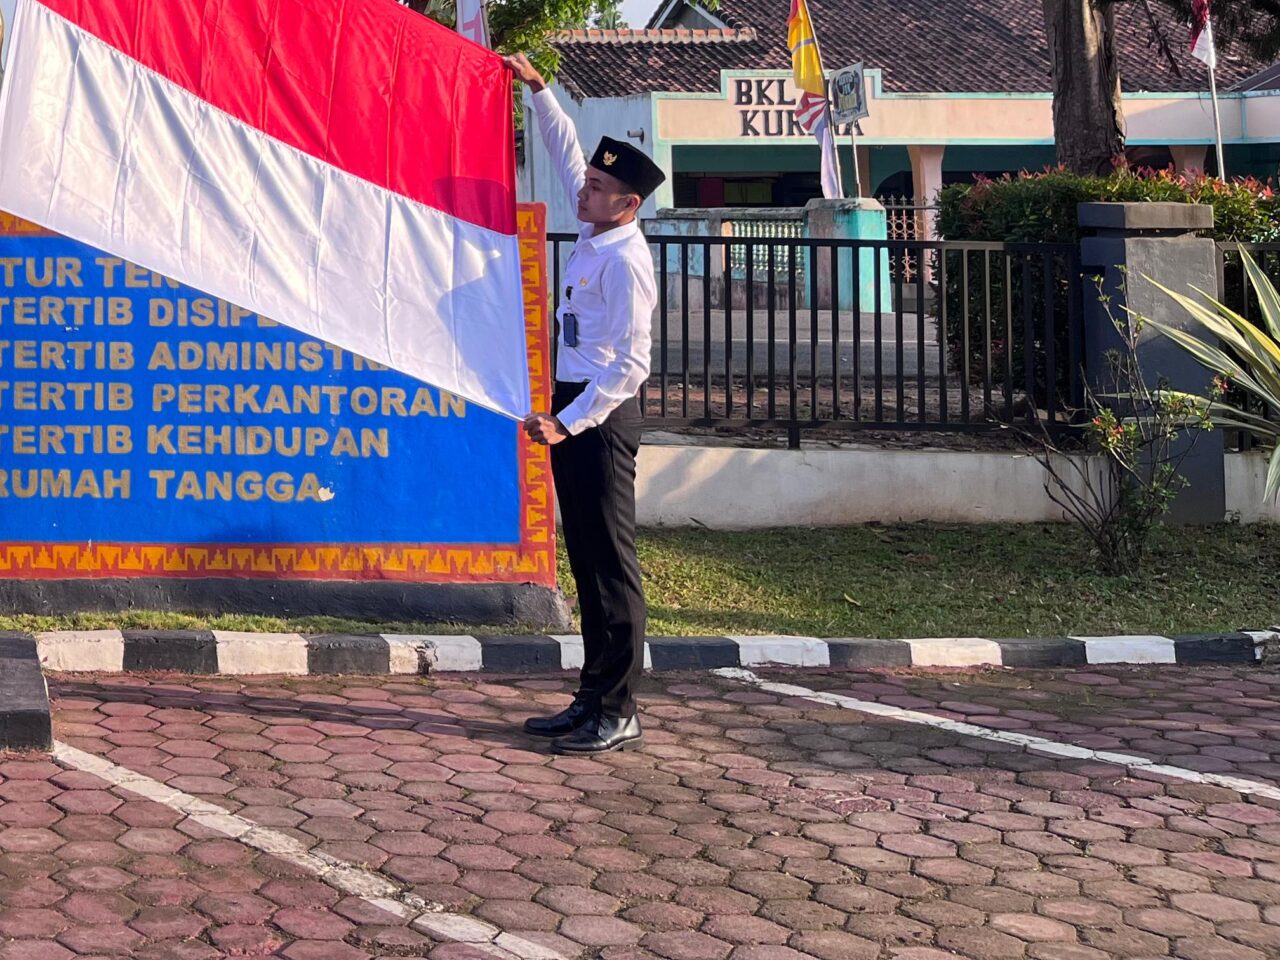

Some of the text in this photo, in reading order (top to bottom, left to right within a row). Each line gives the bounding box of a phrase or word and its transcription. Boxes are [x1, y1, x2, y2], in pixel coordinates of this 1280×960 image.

[735, 79, 796, 105] BKL
[152, 384, 466, 418] PERKANTORAN
[147, 424, 389, 457] KEHIDUPAN
[149, 469, 322, 502] TANGGA
